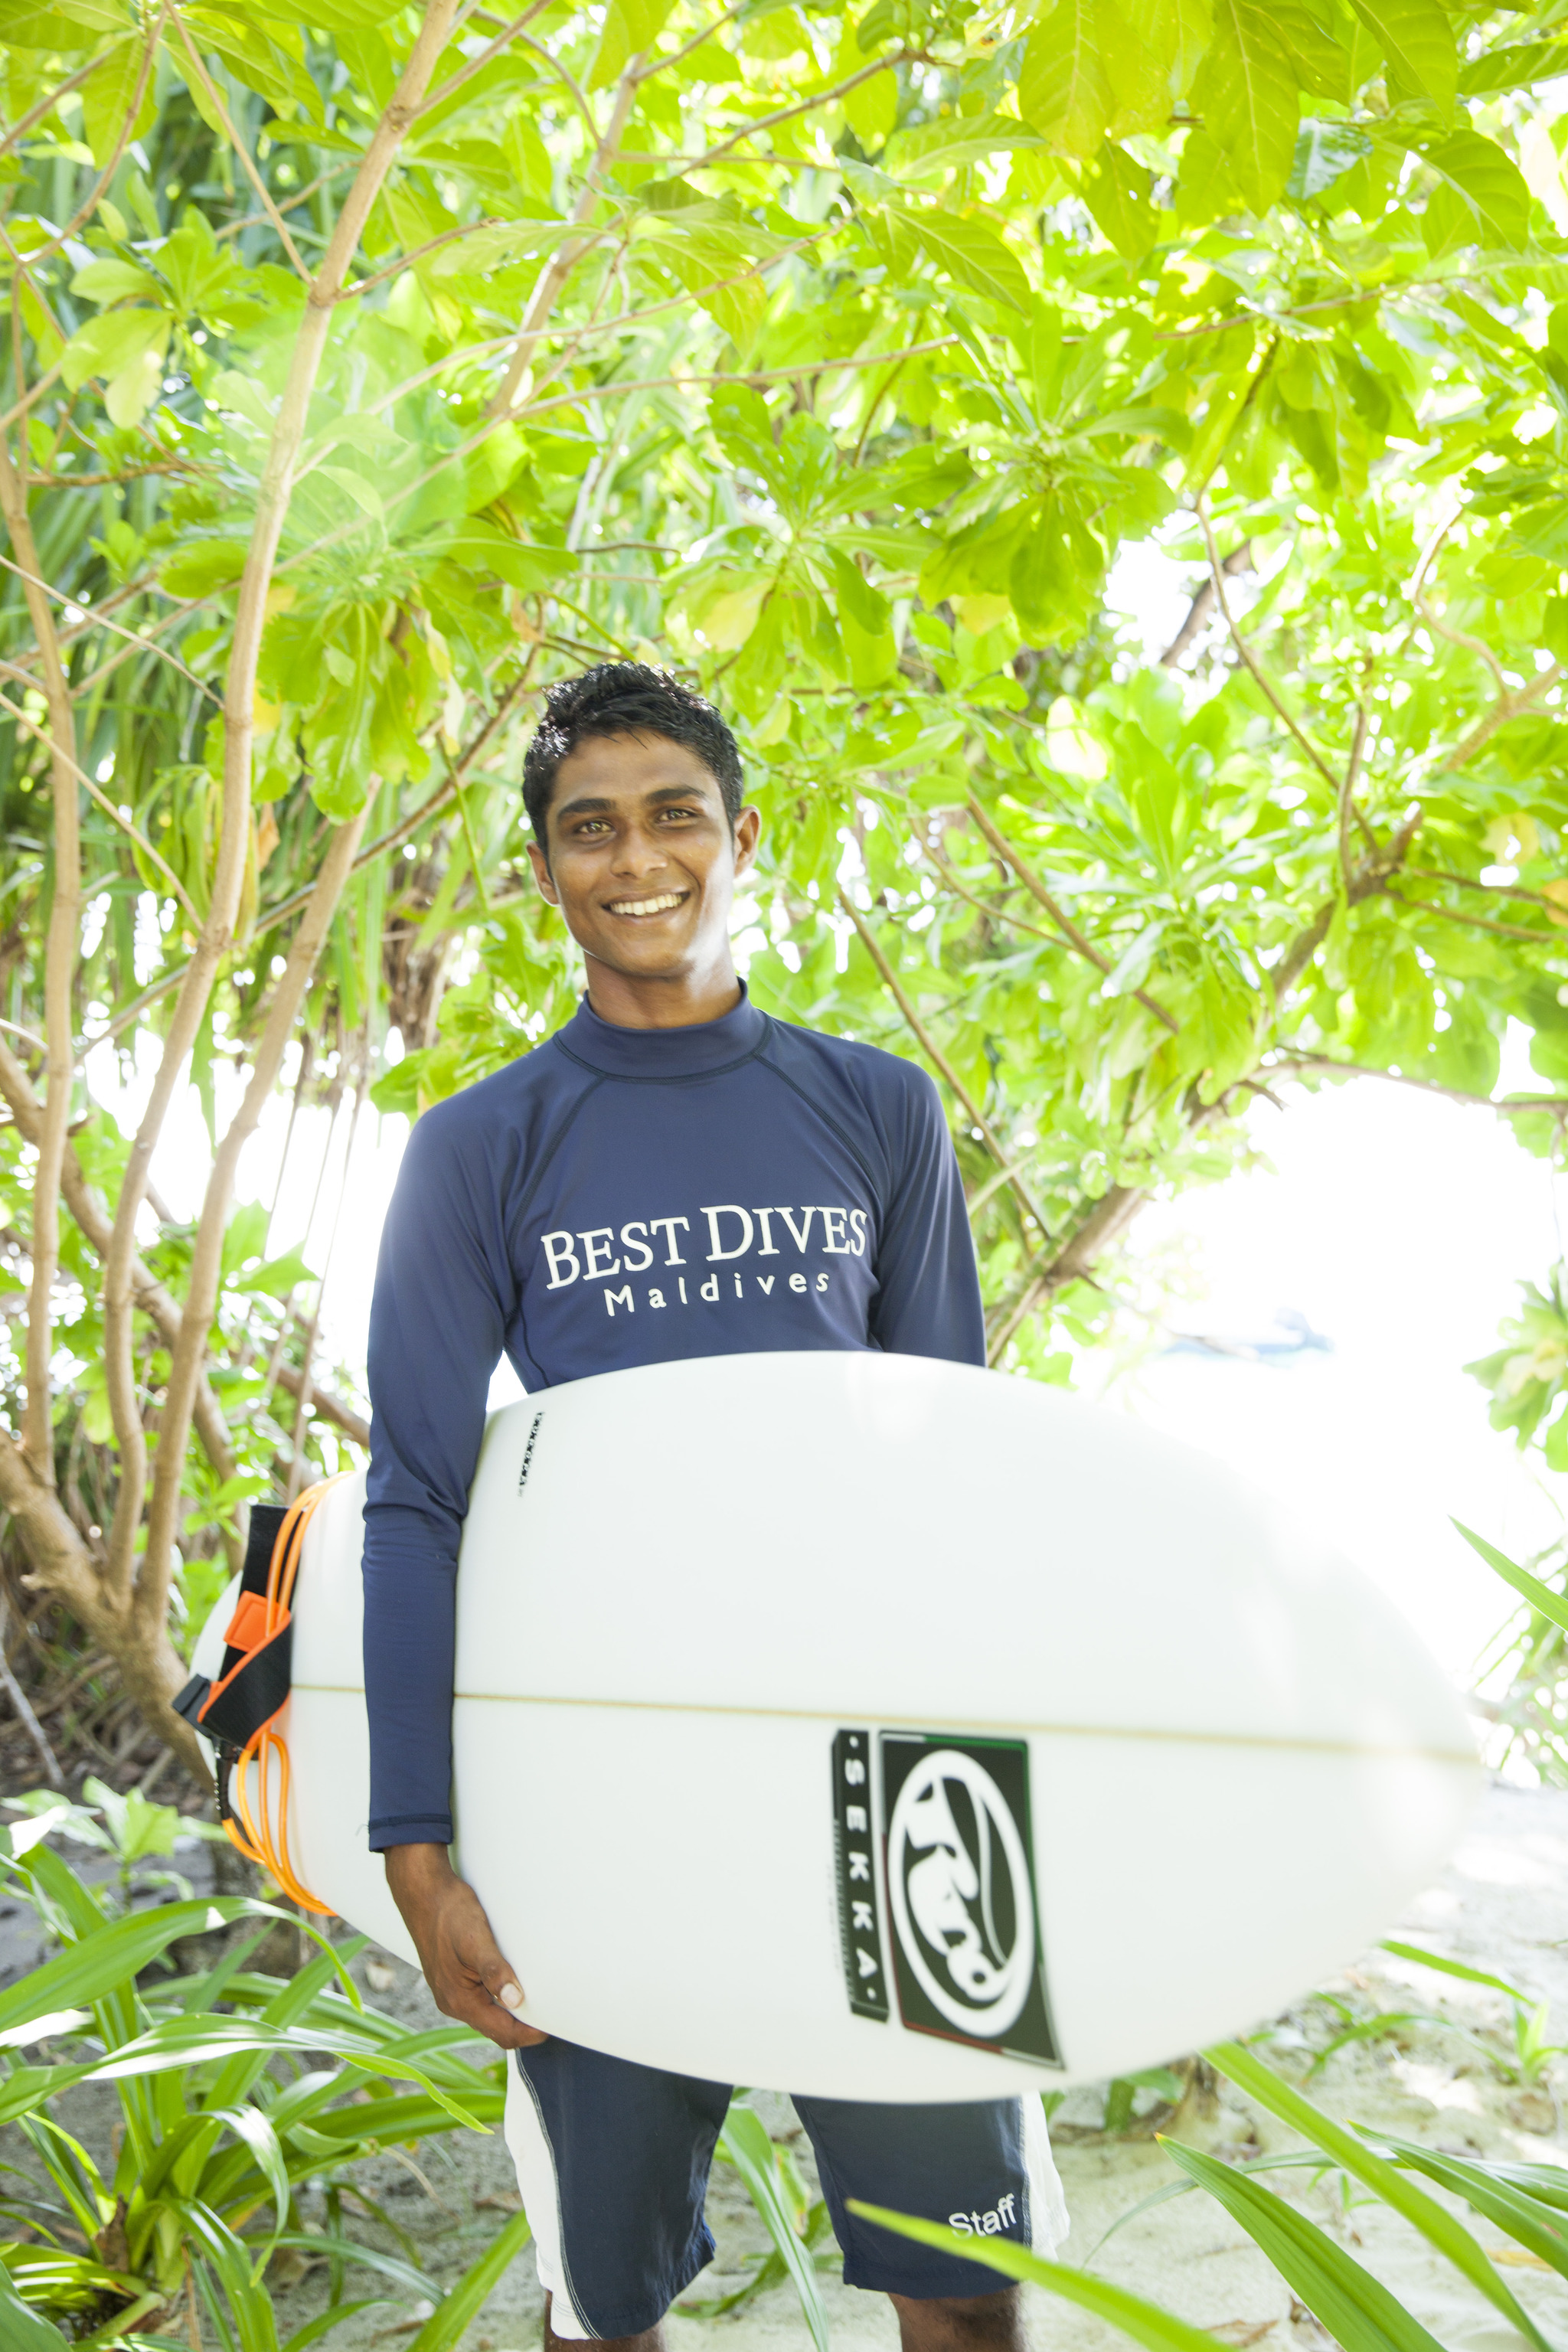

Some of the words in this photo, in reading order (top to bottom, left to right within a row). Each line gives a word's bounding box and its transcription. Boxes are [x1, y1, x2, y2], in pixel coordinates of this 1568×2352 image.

[541, 1217, 690, 1290] BEST
[700, 1204, 867, 1261] DIVES
[603, 1272, 829, 1317] Maldives
[949, 2193, 1017, 2239] Staff
